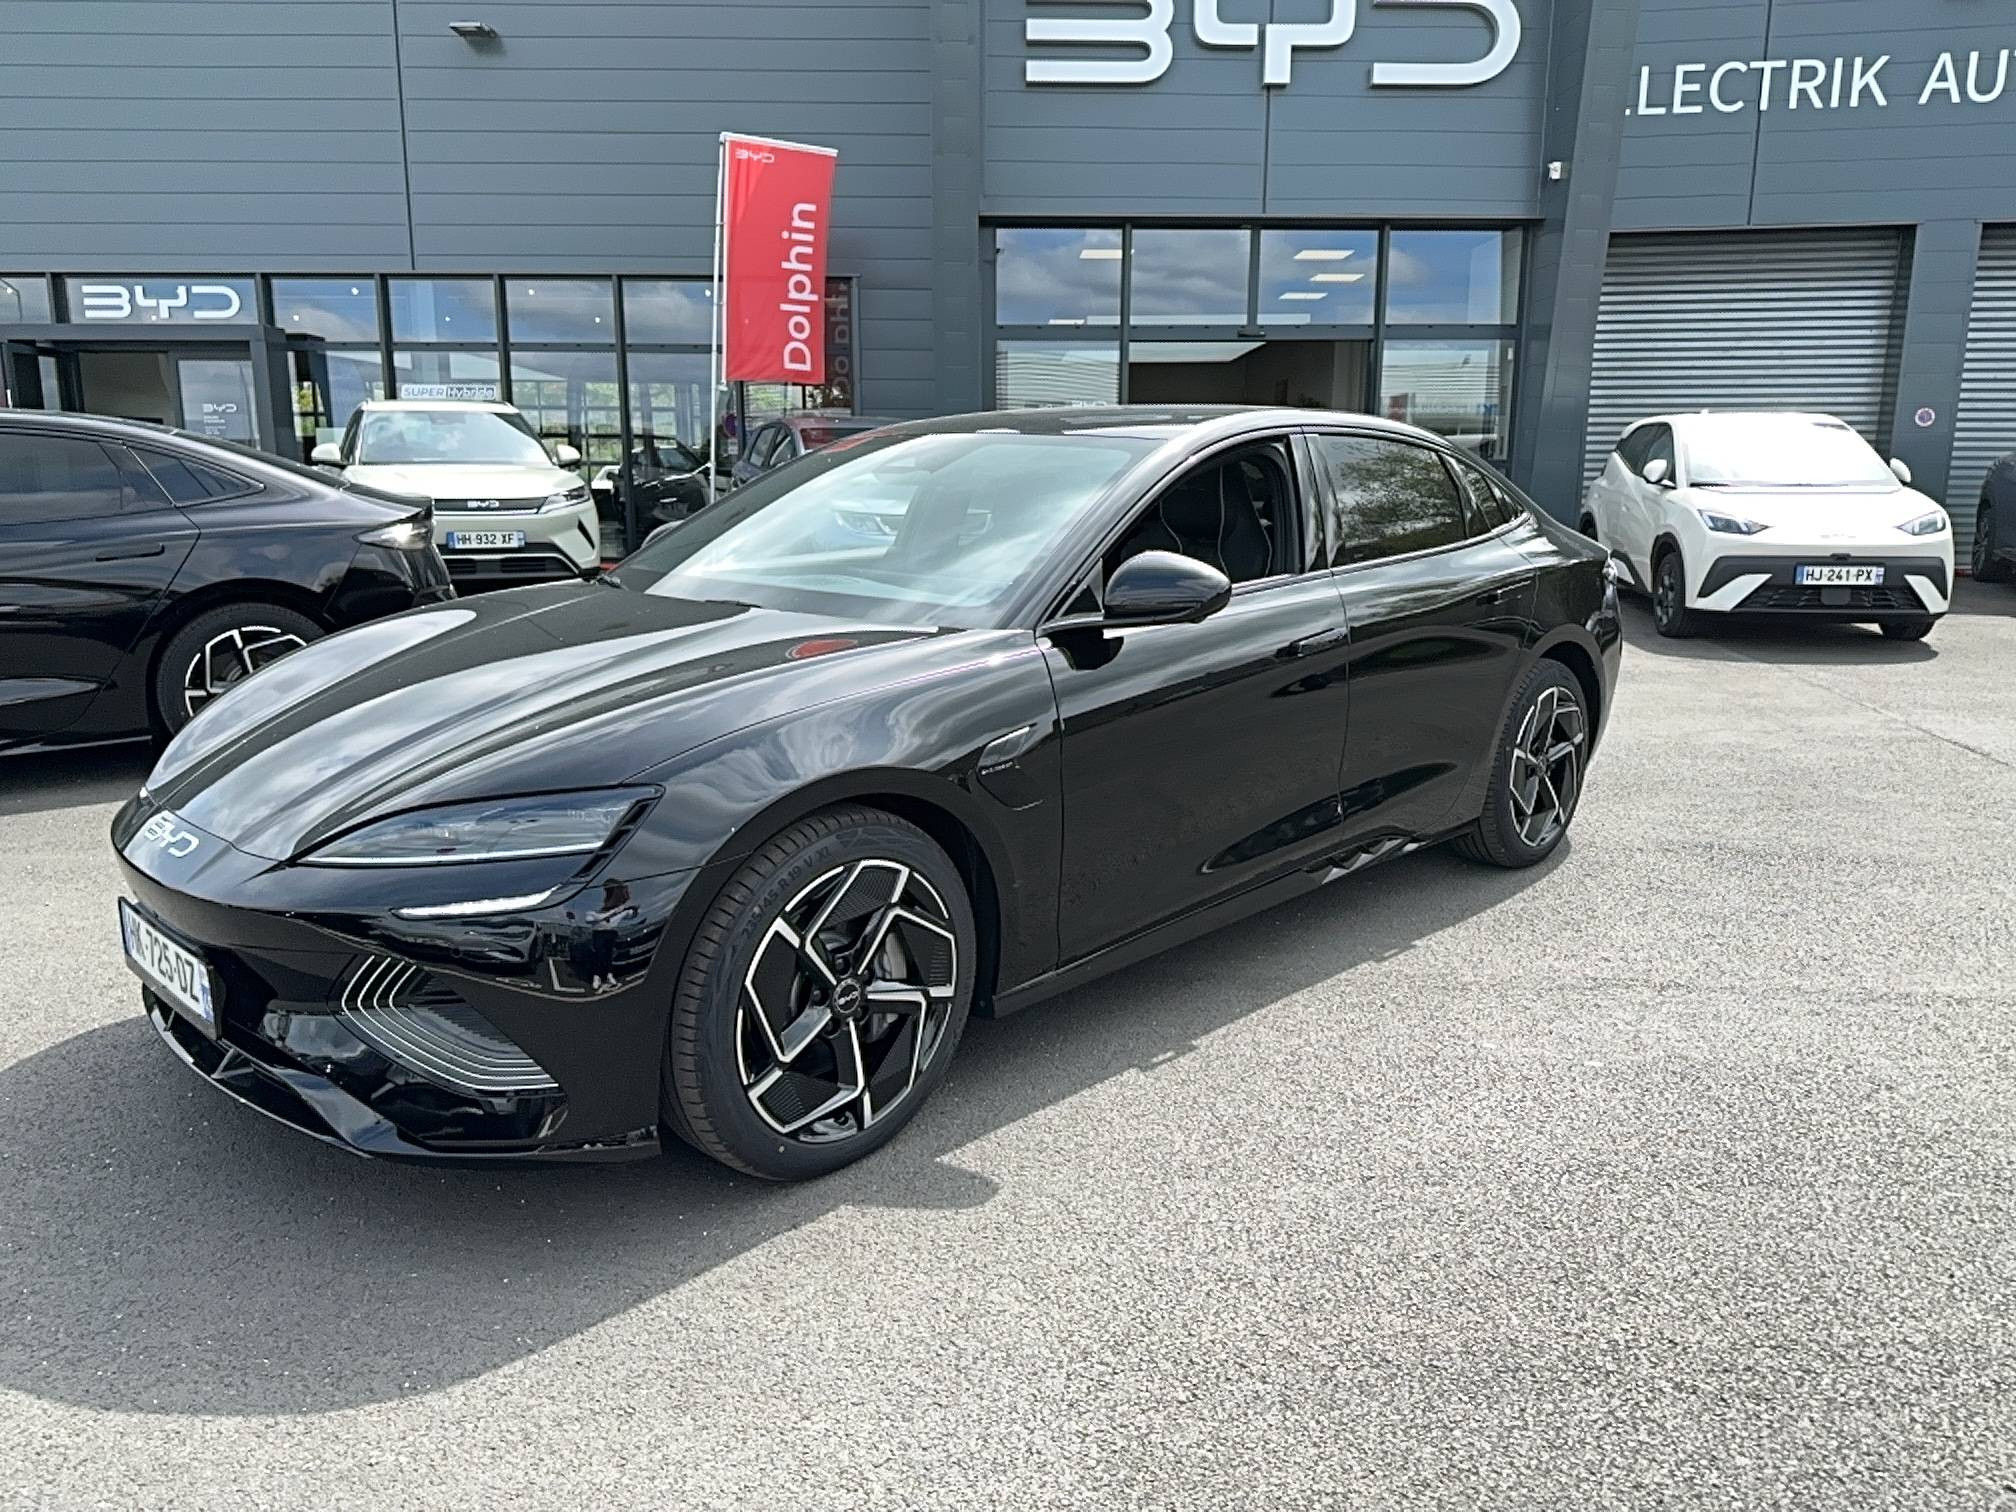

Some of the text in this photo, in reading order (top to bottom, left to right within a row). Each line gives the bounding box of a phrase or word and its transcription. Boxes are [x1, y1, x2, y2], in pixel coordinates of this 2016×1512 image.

[1026, 0, 1521, 86] BYD
[1625, 48, 2016, 116] LECTRIK AU
[735, 149, 775, 163] BYD
[81, 285, 241, 319] BYD
[780, 202, 818, 371] Dolphin
[202, 403, 237, 413] BYD
[144, 817, 199, 857] BYD
